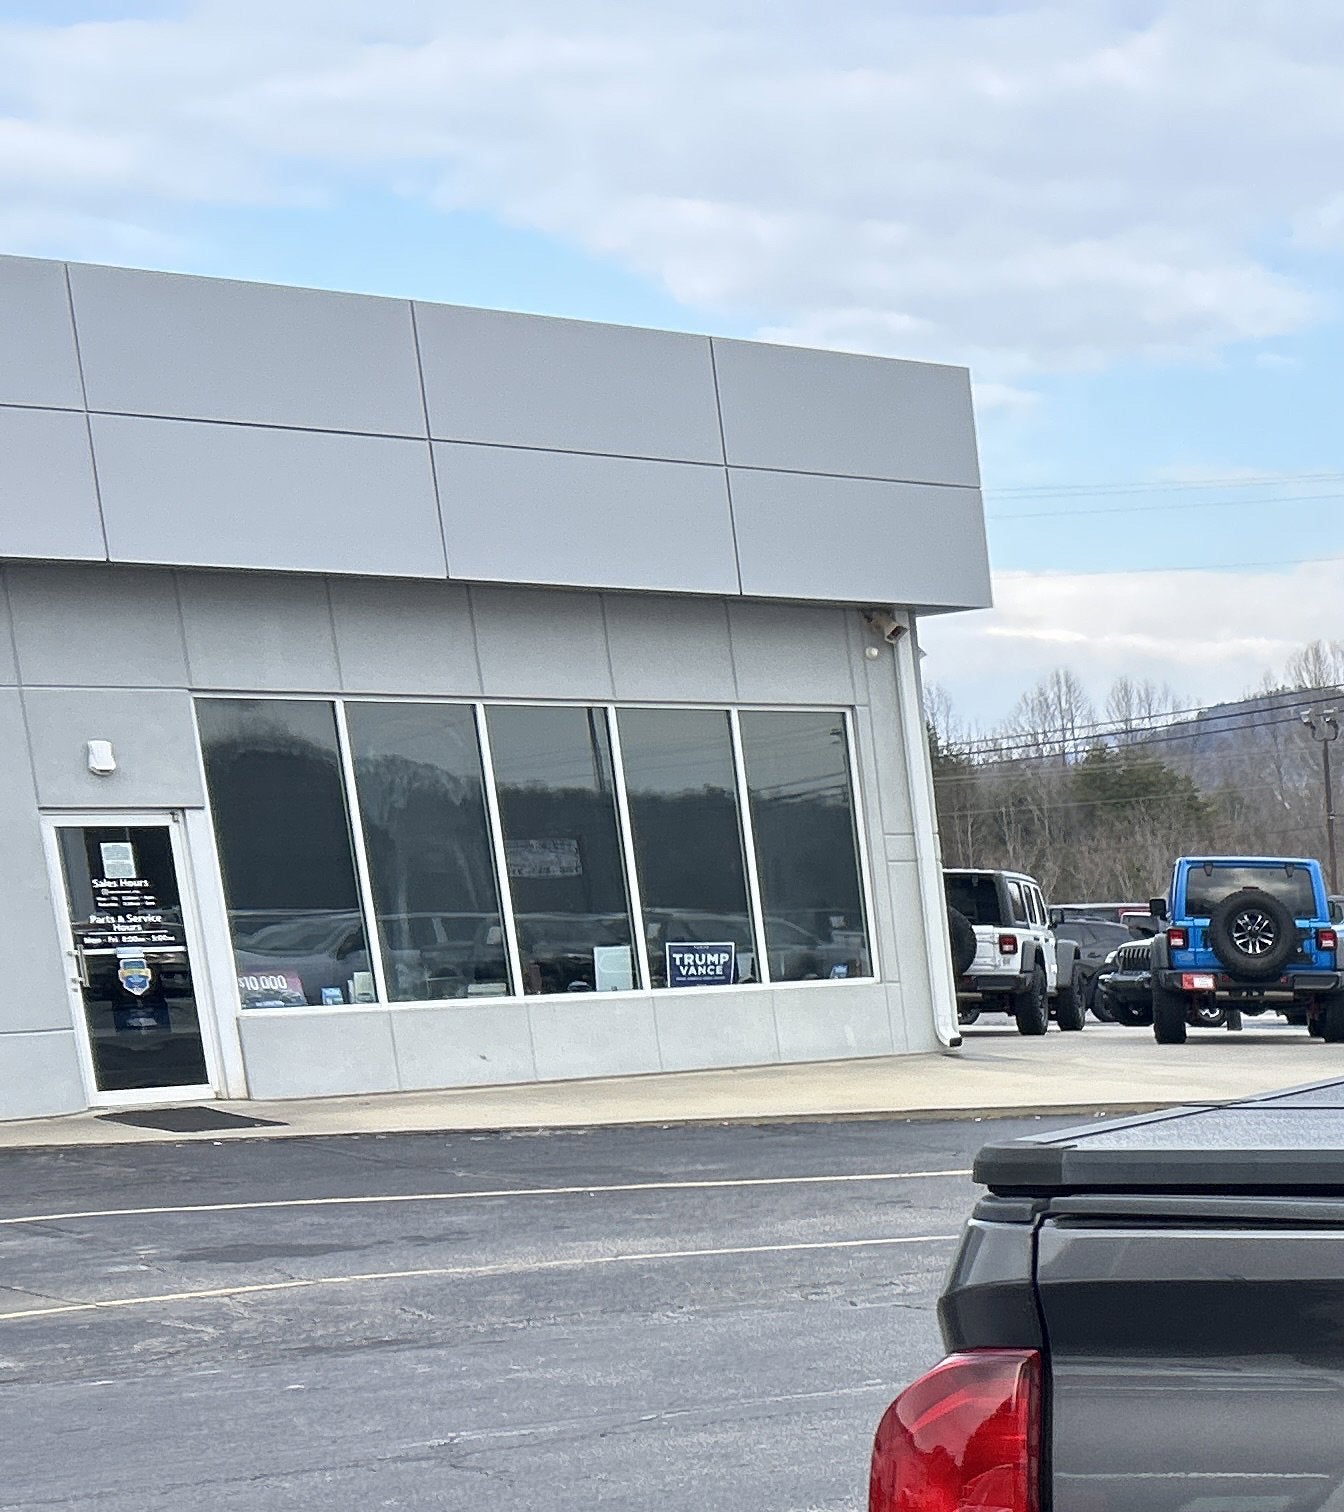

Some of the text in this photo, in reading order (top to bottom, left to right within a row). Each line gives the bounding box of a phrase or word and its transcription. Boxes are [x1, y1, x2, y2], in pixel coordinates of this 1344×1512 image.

[92, 878, 150, 888] Sales Hours
[126, 913, 161, 923] Service
[112, 923, 143, 931] Hours
[672, 953, 729, 966] TRUMP
[679, 965, 723, 976] VANCE
